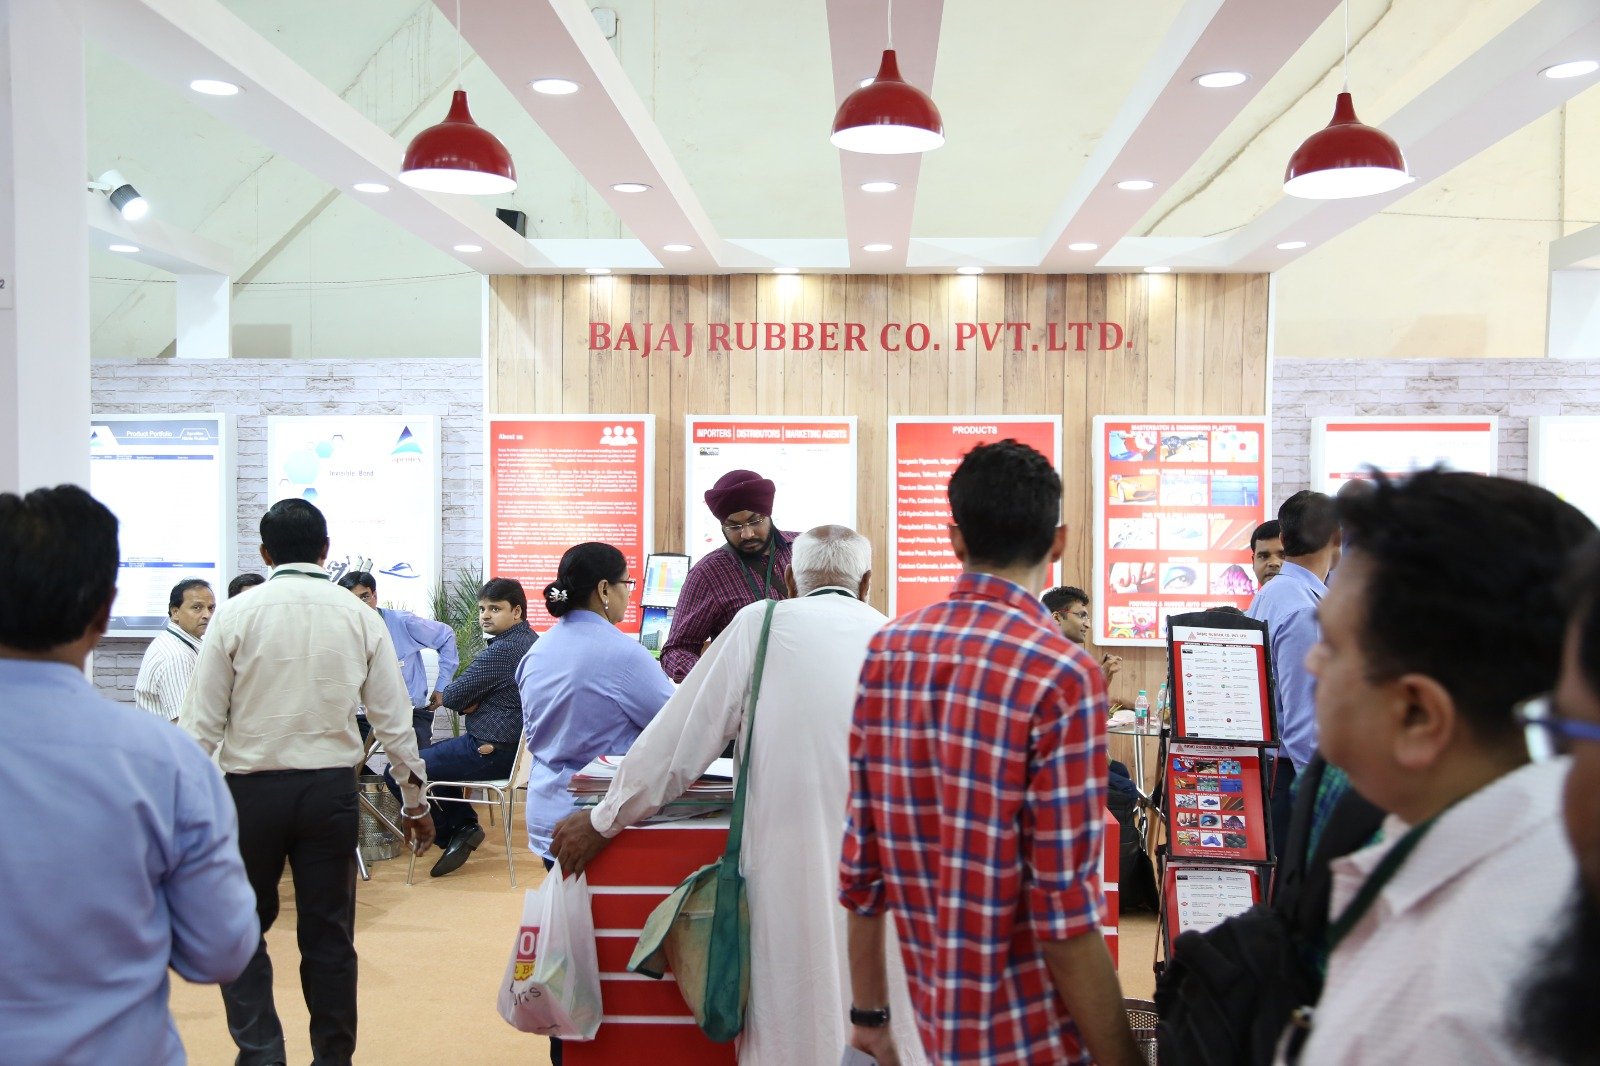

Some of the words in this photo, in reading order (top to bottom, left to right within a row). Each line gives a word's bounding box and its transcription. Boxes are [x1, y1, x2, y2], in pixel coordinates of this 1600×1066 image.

[588, 322, 694, 358] BAJAJ
[708, 322, 868, 352] RUBBER
[880, 323, 940, 352] CO.
[696, 429, 732, 438] IMPORTERS
[736, 430, 780, 438] DISTRIBUTORS
[786, 430, 822, 438] MARKETING
[822, 430, 848, 438] AGENTS
[952, 426, 998, 434] PRODUCTS
